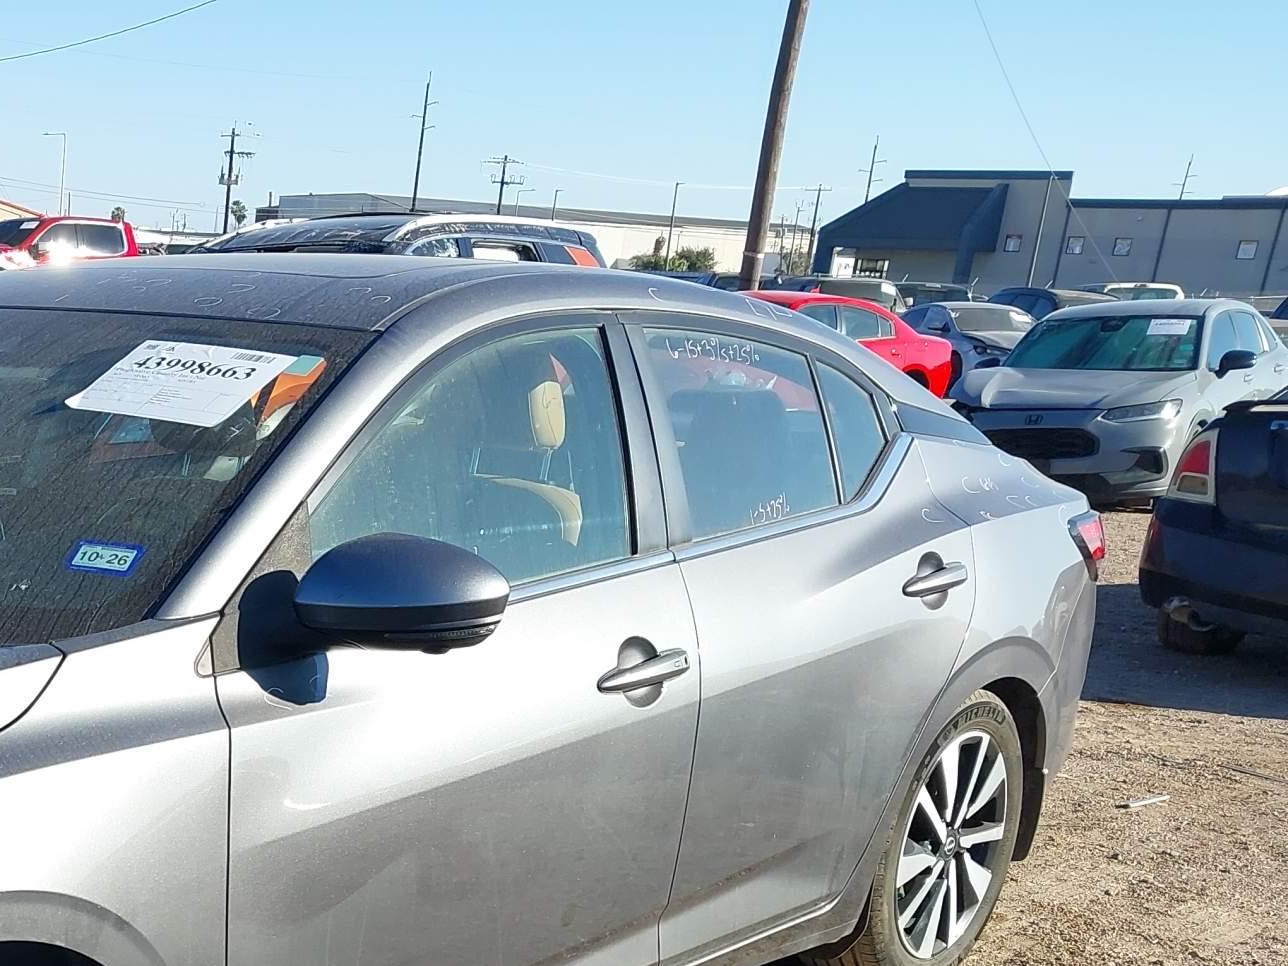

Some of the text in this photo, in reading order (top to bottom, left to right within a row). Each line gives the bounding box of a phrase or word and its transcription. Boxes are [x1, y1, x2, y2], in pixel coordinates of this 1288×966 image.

[133, 355, 257, 381] 43998663
[79, 550, 130, 566] 10 26
